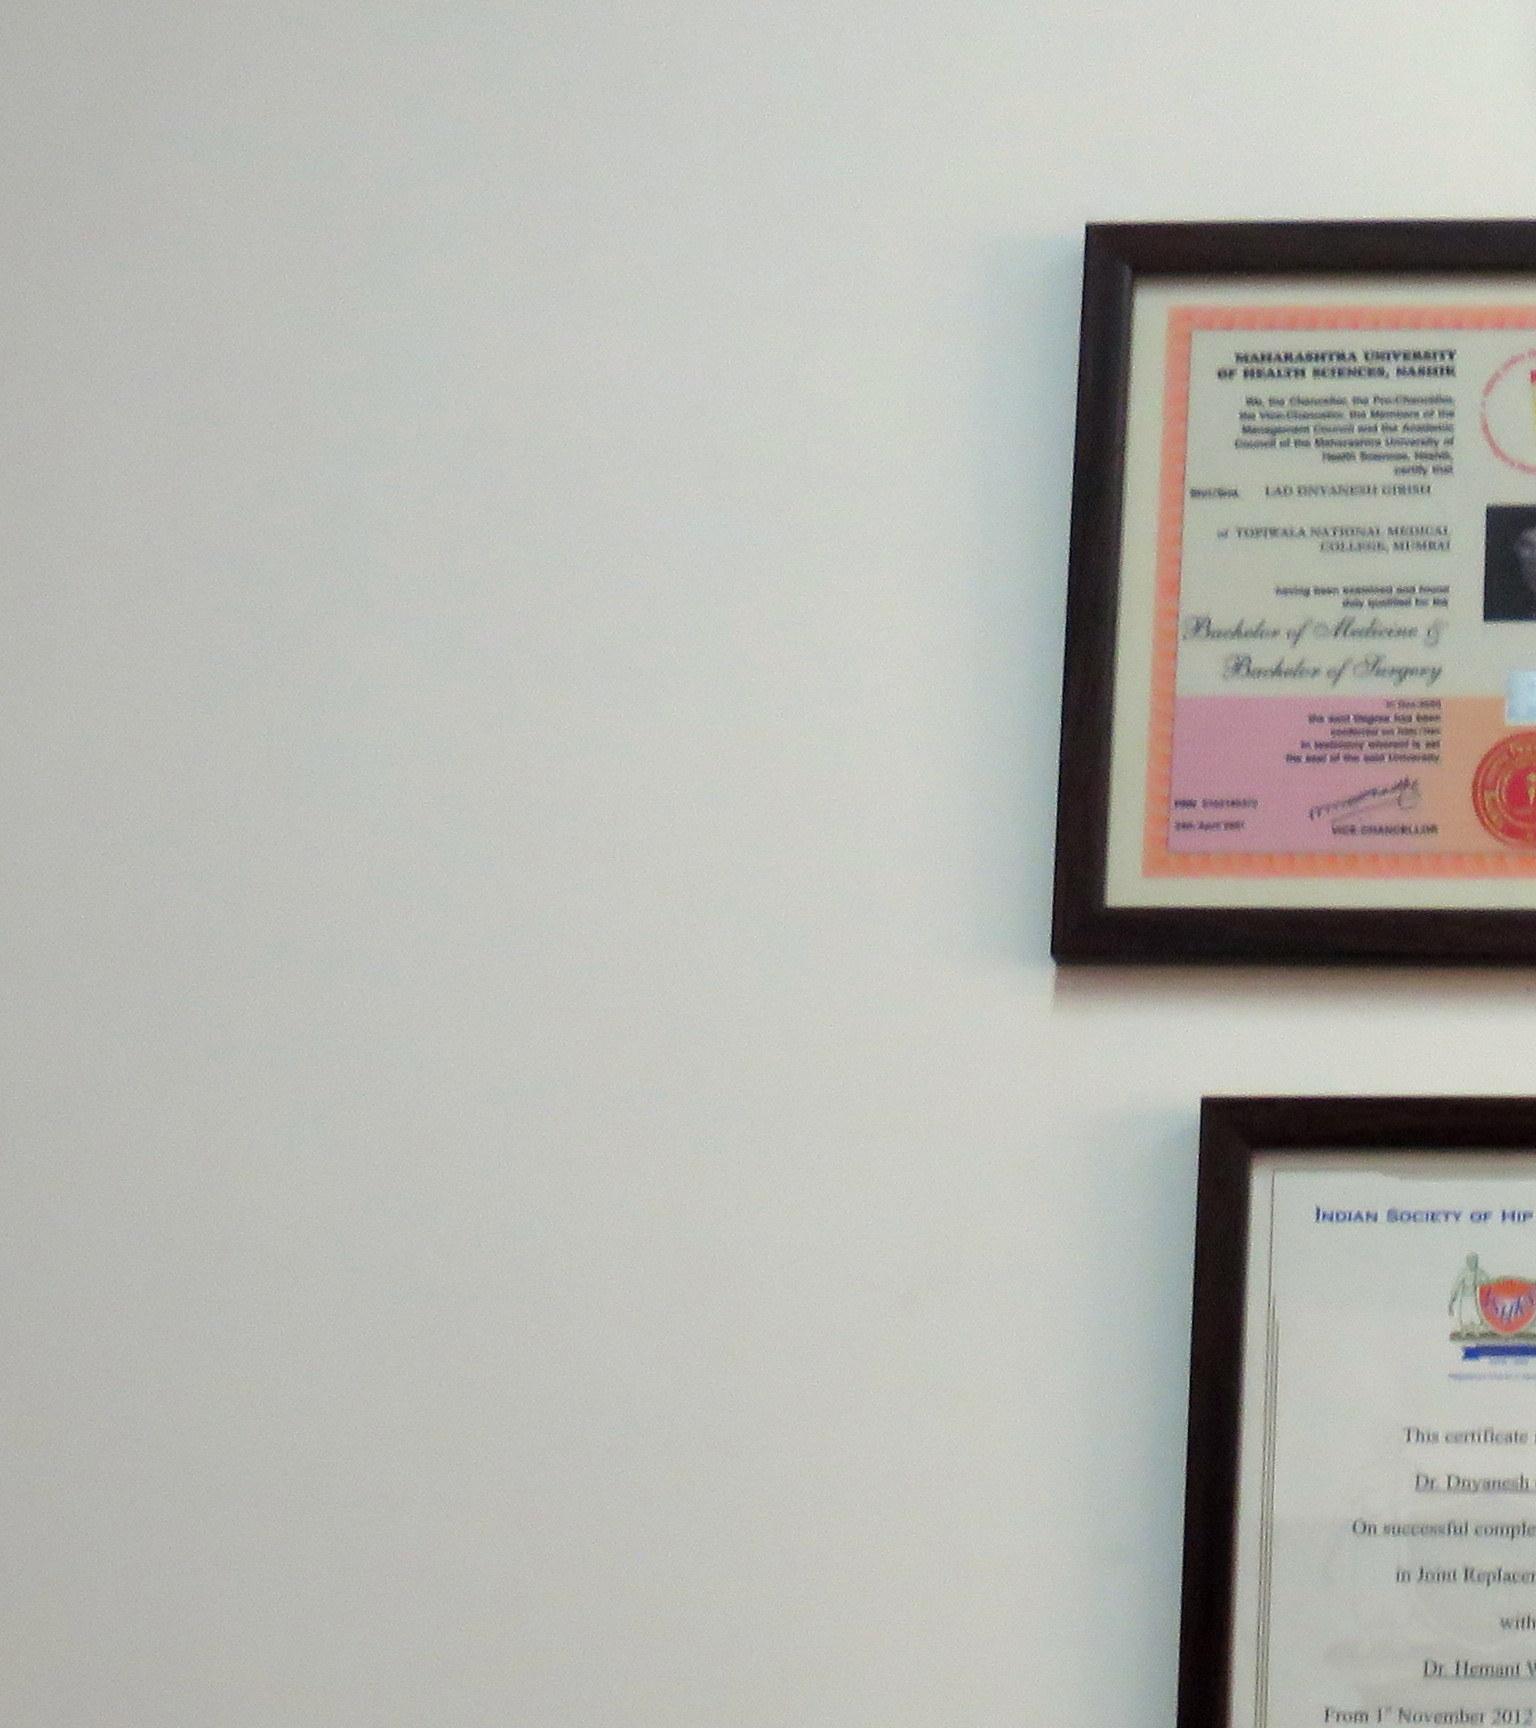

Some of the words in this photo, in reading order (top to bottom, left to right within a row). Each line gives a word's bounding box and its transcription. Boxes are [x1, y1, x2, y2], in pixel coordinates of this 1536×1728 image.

[1315, 1205, 1380, 1225] INDIAN
[1387, 1208, 1464, 1225] SOCIETY
[1470, 1211, 1494, 1225] OF
[1501, 1209, 1535, 1225] HIP
[1404, 1427, 1441, 1446] This
[1444, 1427, 1530, 1446] certificate
[1446, 1473, 1530, 1494] Dnyanesh
[1351, 1518, 1378, 1538] On
[1382, 1518, 1470, 1539] successful
[1396, 1568, 1413, 1585] in
[1417, 1565, 1459, 1585] Joint
[1454, 1659, 1521, 1680] Hemant
[1324, 1707, 1371, 1725] From
[1398, 1707, 1486, 1728] November
[1492, 1708, 1534, 1728] 2012
